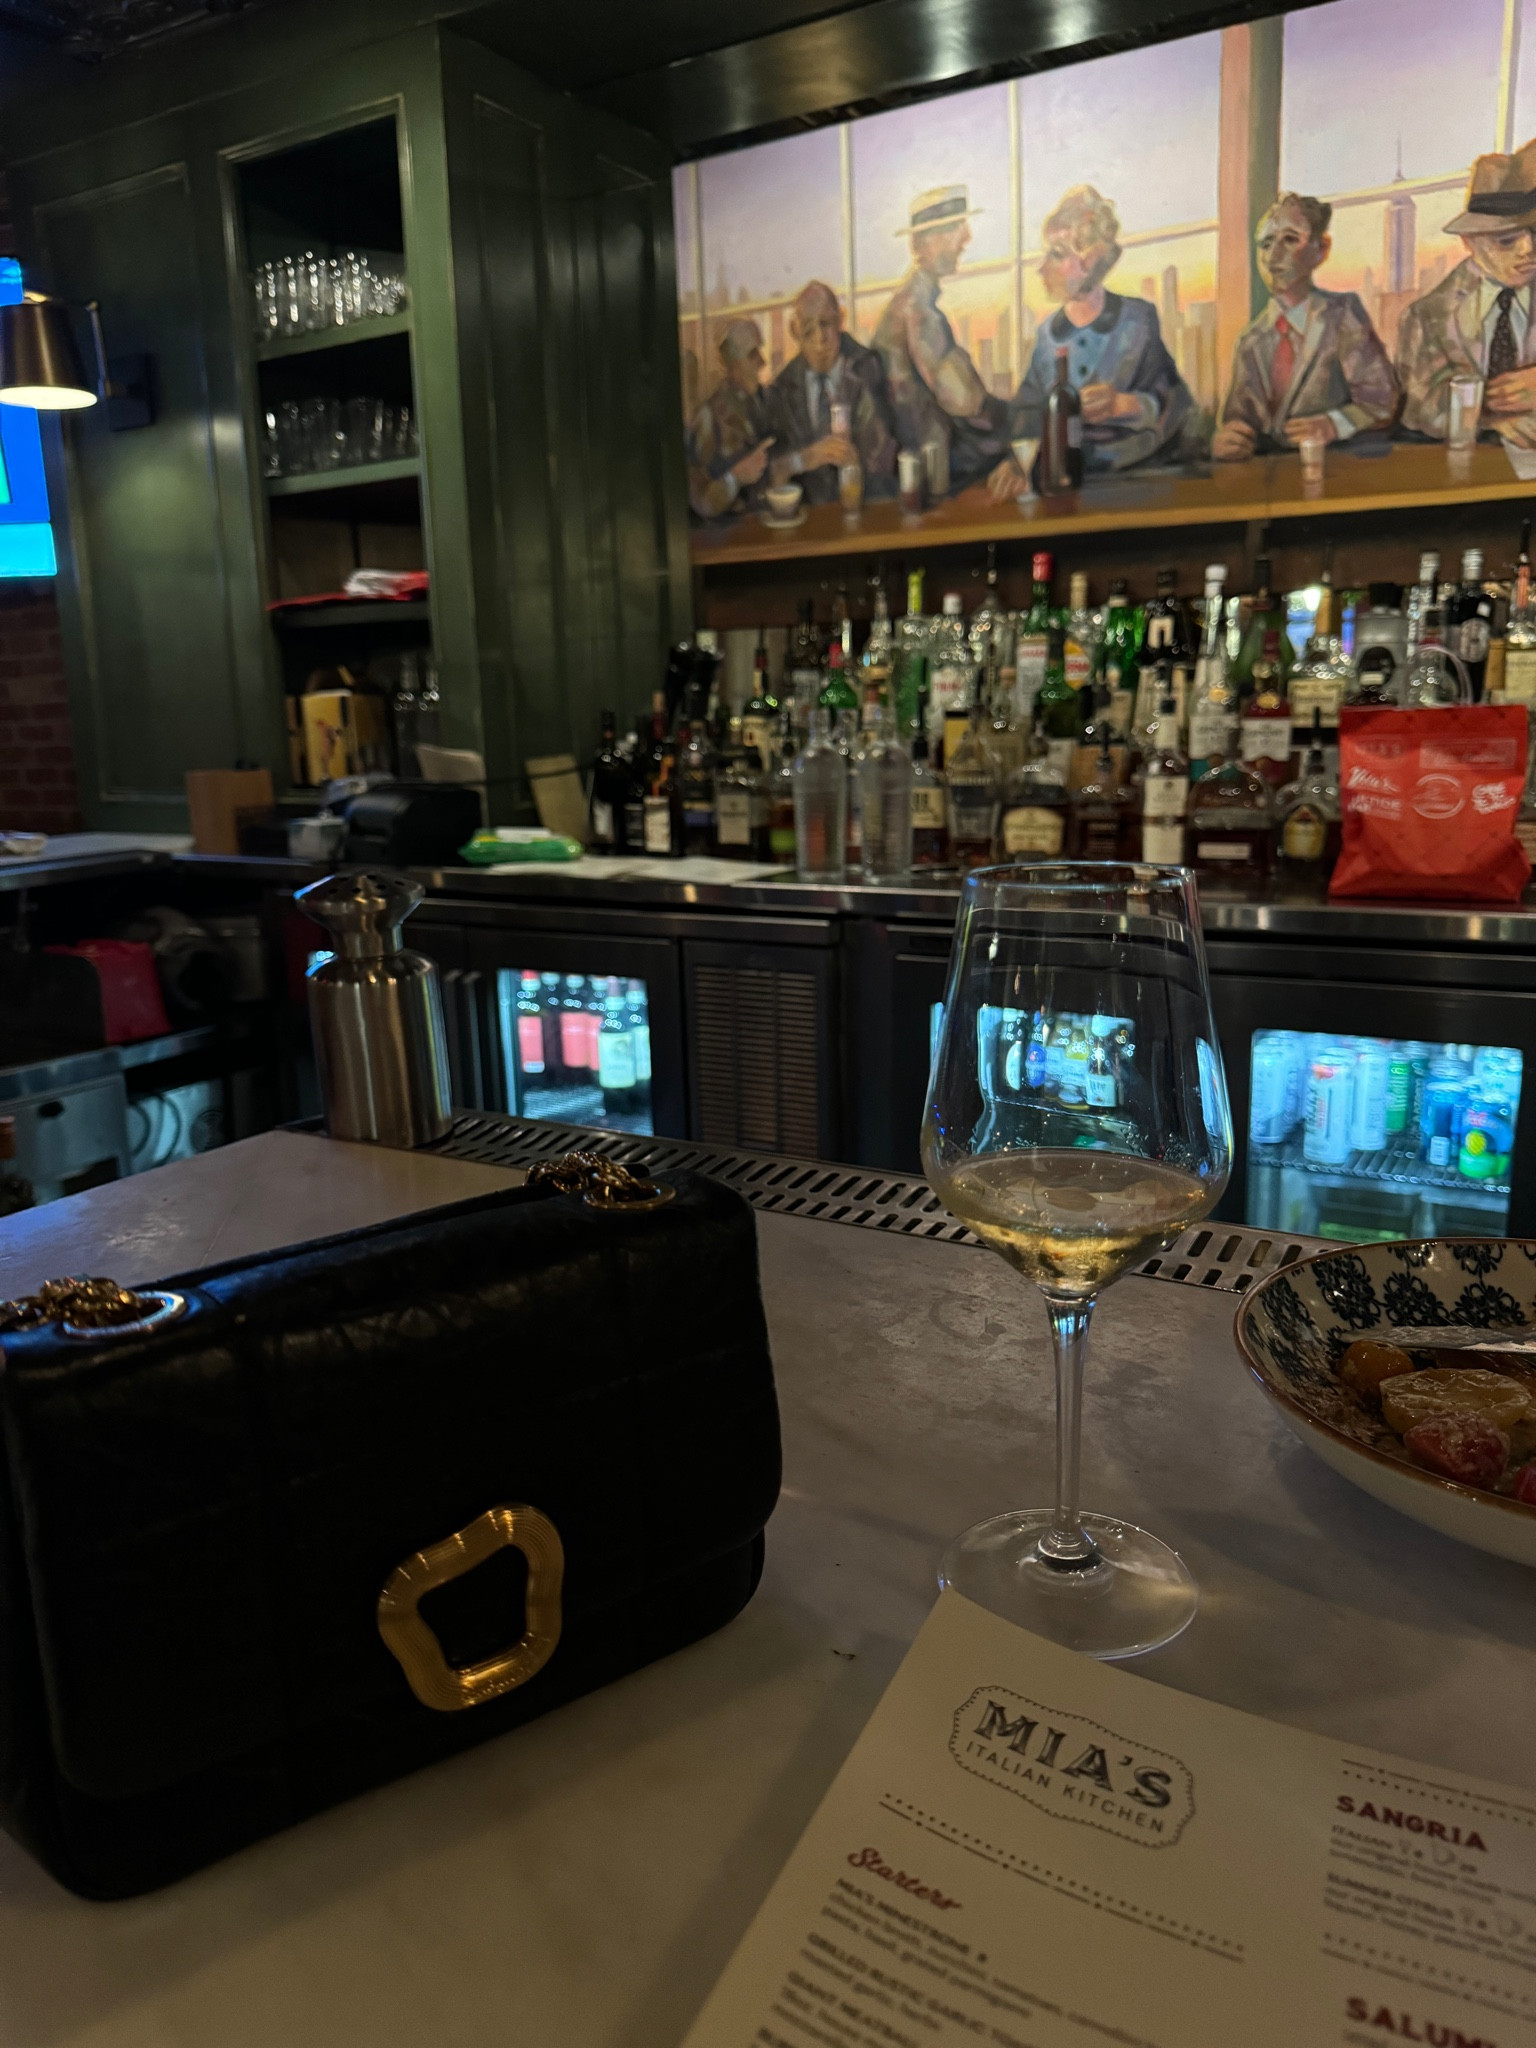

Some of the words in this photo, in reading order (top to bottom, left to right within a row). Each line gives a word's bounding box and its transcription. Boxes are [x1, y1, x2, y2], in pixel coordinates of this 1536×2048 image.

[966, 1741, 1050, 1788] ITALIAN
[1063, 1784, 1165, 1833] KITCHEN
[973, 1699, 1172, 1809] MIA'S
[1335, 1795, 1488, 1852] SANGRIA
[847, 1847, 963, 1910] Starters
